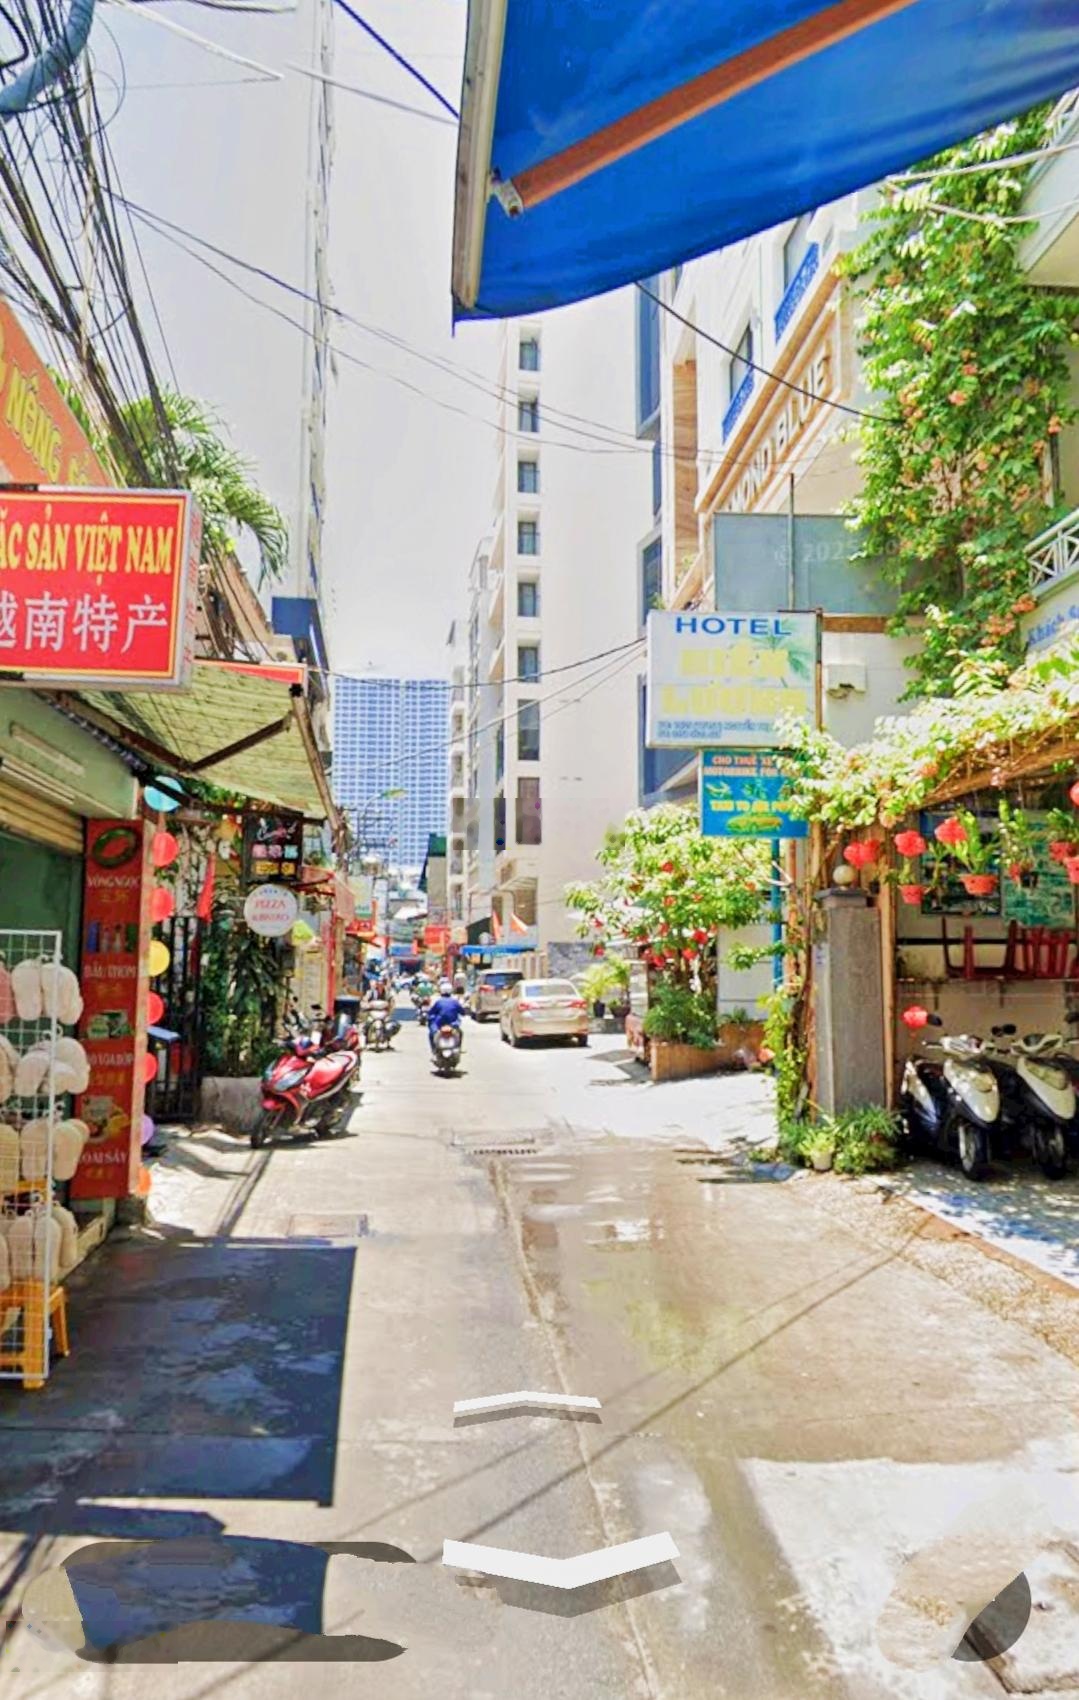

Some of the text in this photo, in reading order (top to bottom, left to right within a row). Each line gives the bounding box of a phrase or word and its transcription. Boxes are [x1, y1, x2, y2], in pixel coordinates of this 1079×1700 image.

[774, 350, 829, 448] BLUE
[25, 503, 71, 571] SẢN
[74, 511, 123, 586] VIỆT
[125, 524, 174, 575] NAM
[676, 616, 792, 635] HOTEL
